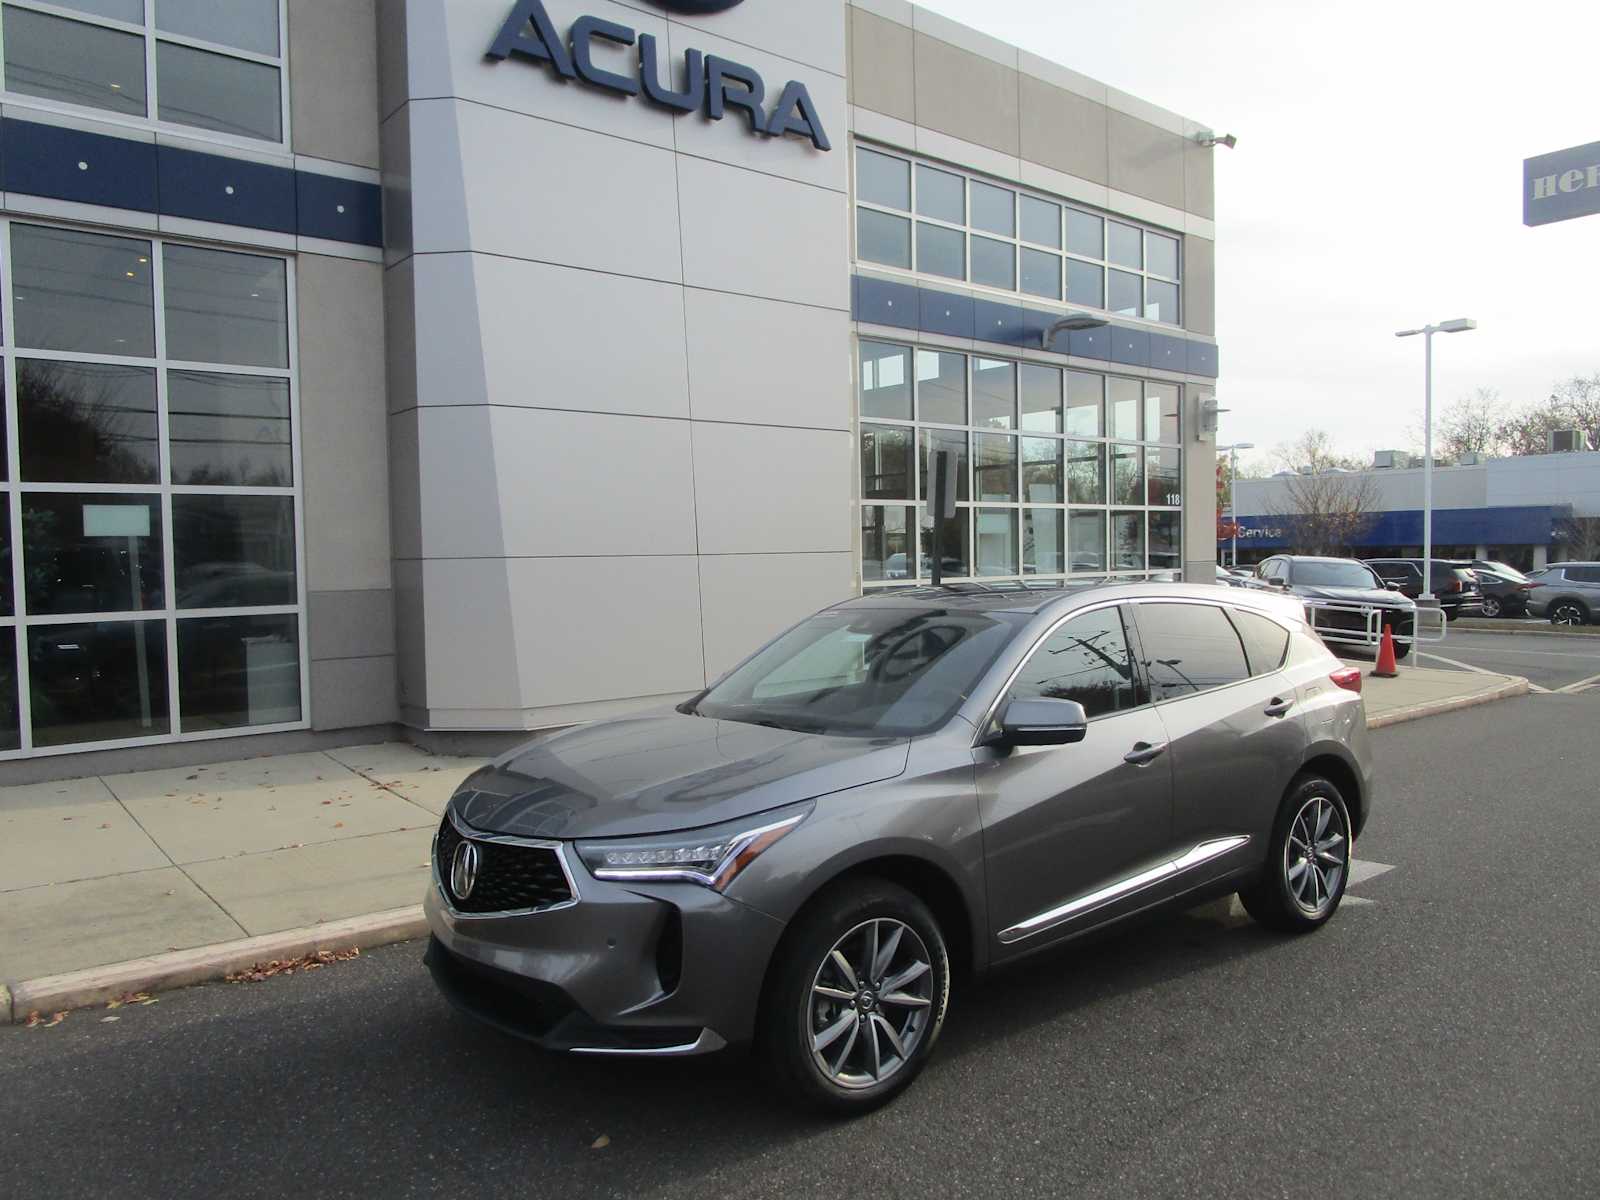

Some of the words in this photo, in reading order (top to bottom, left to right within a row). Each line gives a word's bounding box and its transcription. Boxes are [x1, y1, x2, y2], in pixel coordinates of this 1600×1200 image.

[486, 0, 831, 152] ACURA
[1166, 494, 1180, 505] 118
[1237, 526, 1282, 538] Service
